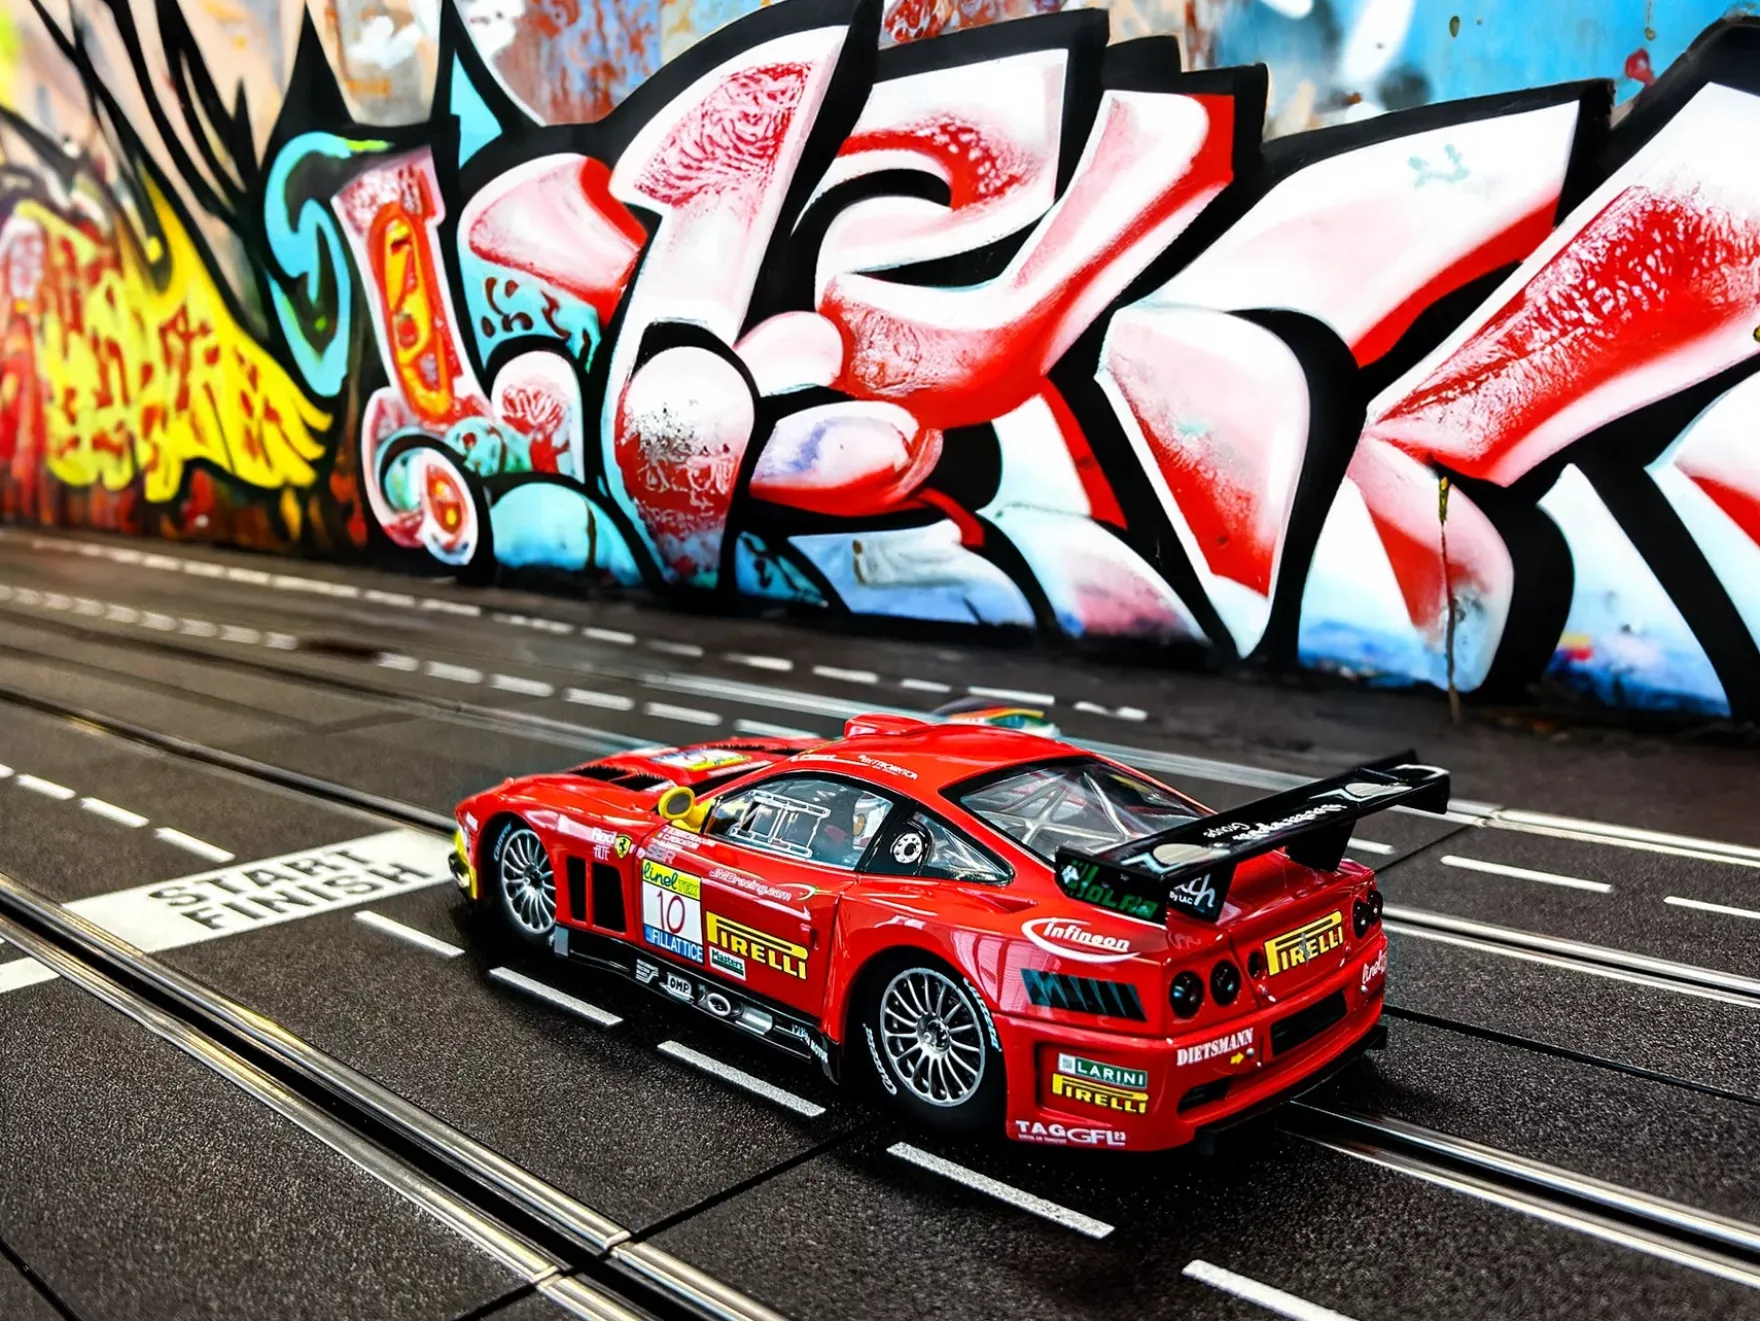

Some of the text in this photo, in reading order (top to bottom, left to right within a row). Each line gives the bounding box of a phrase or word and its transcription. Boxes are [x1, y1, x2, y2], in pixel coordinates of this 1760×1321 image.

[149, 849, 374, 907] START
[180, 862, 435, 930] FINISH
[657, 890, 686, 935] 10
[652, 926, 704, 963] FILLATTICE
[706, 911, 809, 980] PIRELLI
[1264, 909, 1344, 976] PIRELLI
[669, 976, 690, 994] OMP
[1176, 1028, 1254, 1066] DIETSMANN
[1052, 1072, 1149, 1114] PIRELLI
[1077, 1061, 1144, 1085] LARINI
[1015, 1120, 1067, 1137] TAG
